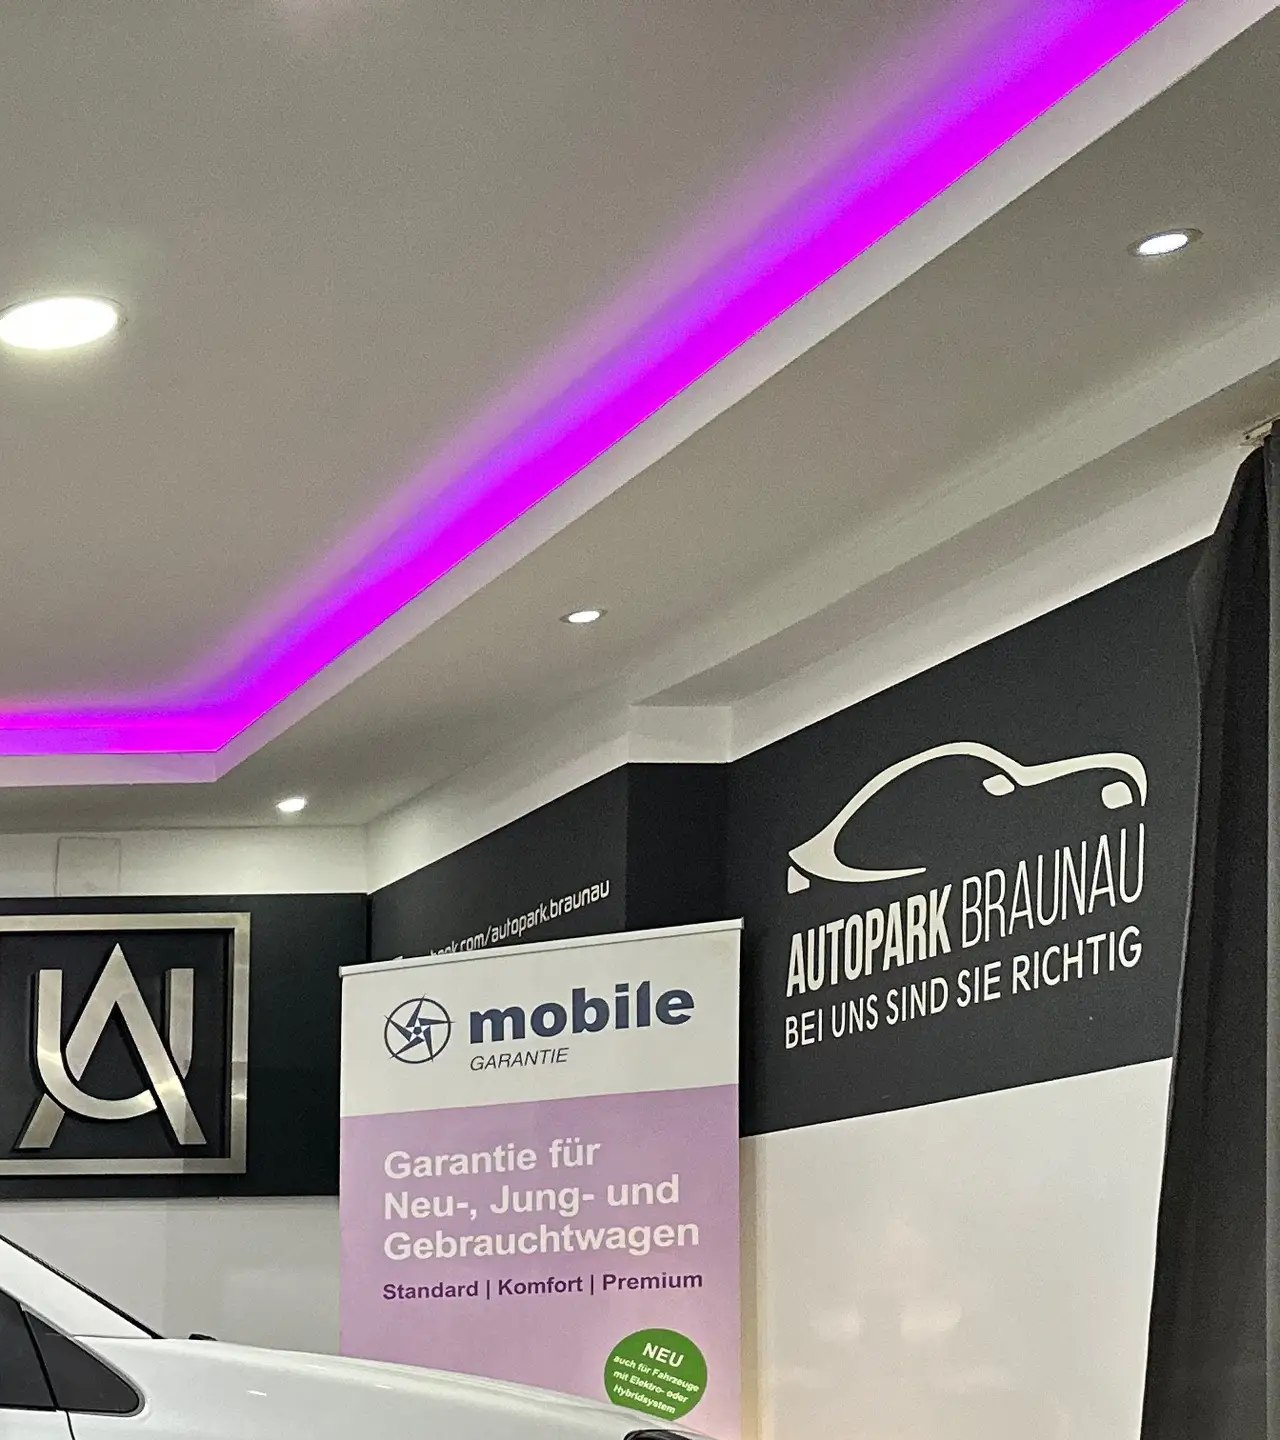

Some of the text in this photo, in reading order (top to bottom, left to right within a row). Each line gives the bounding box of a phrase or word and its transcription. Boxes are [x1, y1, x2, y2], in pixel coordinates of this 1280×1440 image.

[786, 822, 1145, 998] AUTOPARK BRAUNAU
[785, 925, 1143, 1050] BEI UNS SIND SIE RICHTIG
[469, 980, 696, 1045] mobile
[469, 1047, 570, 1072] GARANTIE
[383, 1136, 602, 1179] Garantie für
[383, 1173, 680, 1221] Neu-, Jung- und
[383, 1222, 700, 1261] Gebrauchtwagen
[382, 1280, 479, 1300] Standard
[497, 1275, 584, 1296] Komfort
[601, 1270, 704, 1291] Premium
[612, 1355, 700, 1393] auch für Fahrzeuge
[641, 1342, 685, 1368] NEU
[612, 1370, 689, 1404] mit Elektro- oder
[612, 1384, 676, 1414] Hybridsystem
